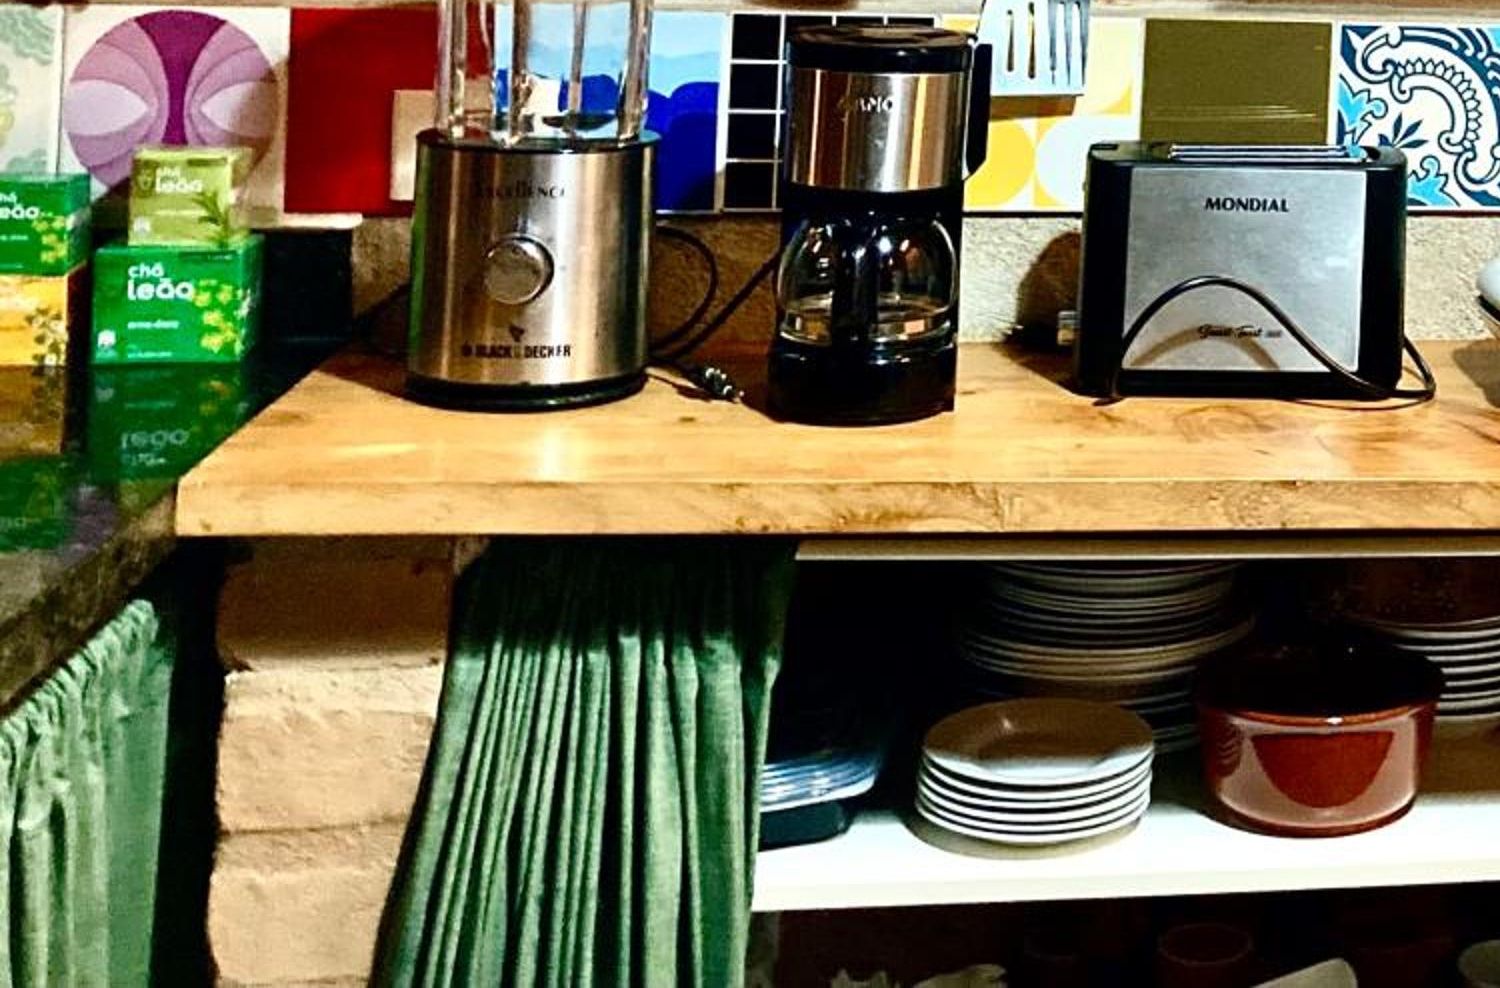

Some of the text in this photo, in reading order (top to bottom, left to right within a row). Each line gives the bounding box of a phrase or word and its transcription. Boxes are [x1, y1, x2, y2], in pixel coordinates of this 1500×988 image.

[1204, 197, 1289, 213] MONDIAL
[128, 262, 165, 278] chá
[128, 277, 193, 300] leão
